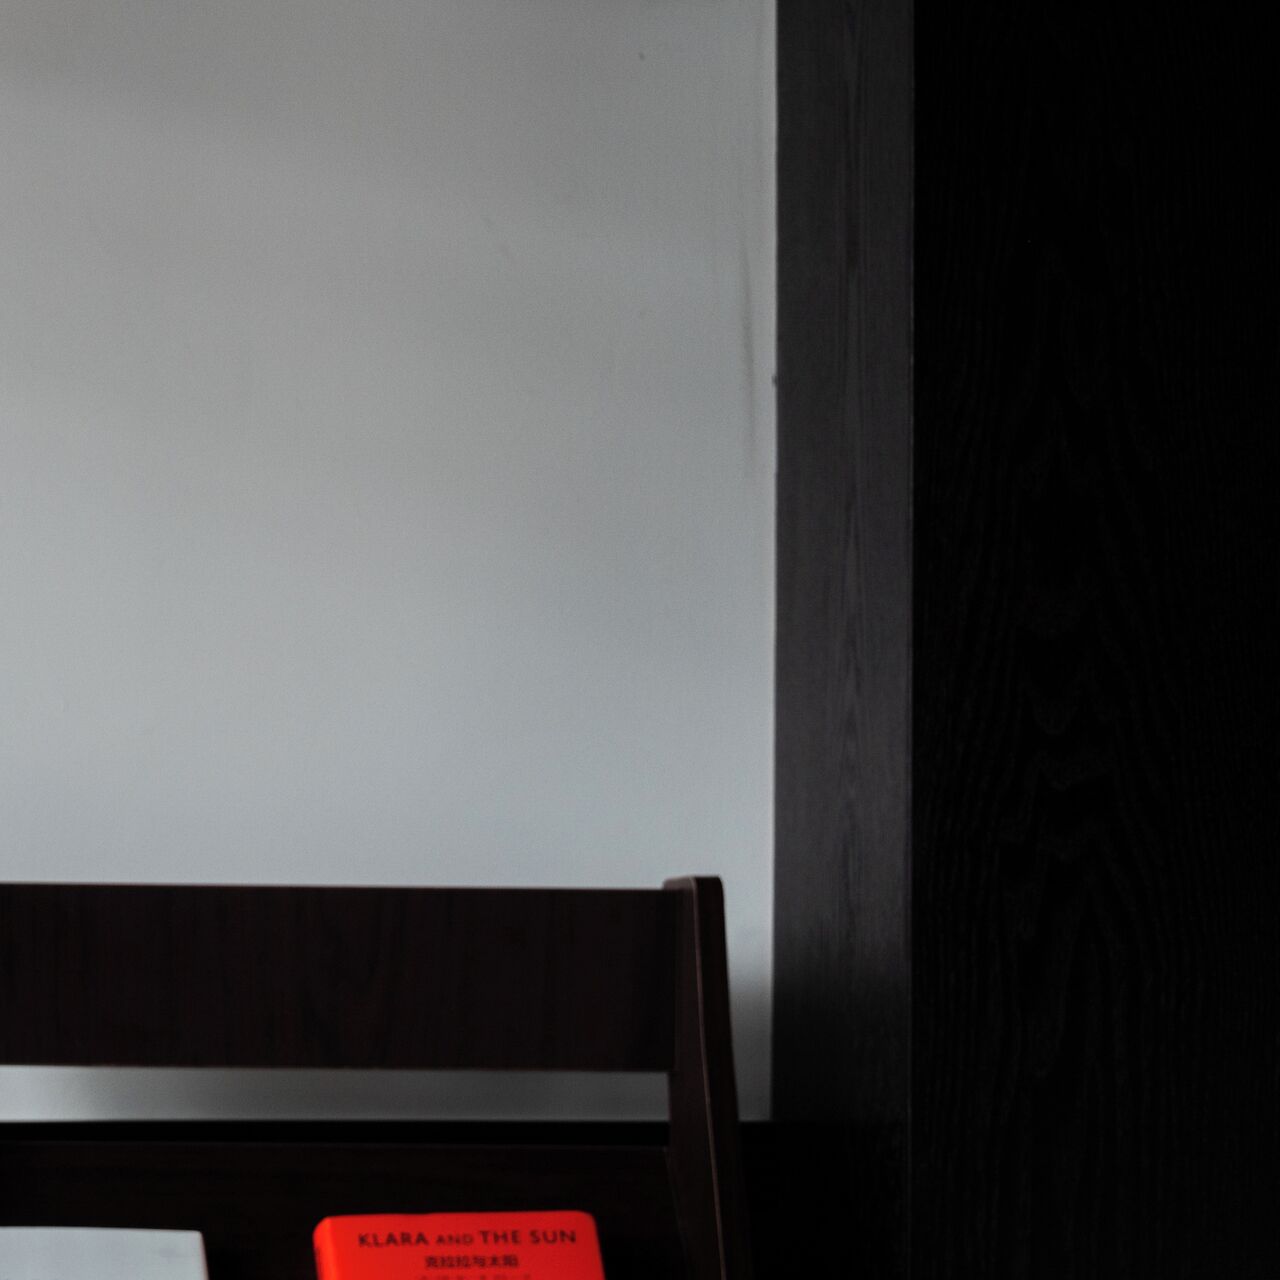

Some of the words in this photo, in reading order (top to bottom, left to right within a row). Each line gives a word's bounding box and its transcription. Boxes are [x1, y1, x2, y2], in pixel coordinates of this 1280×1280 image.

[358, 1231, 428, 1247] KLARA
[436, 1234, 474, 1245] AND
[479, 1230, 521, 1244] THE
[529, 1229, 577, 1244] SUN
